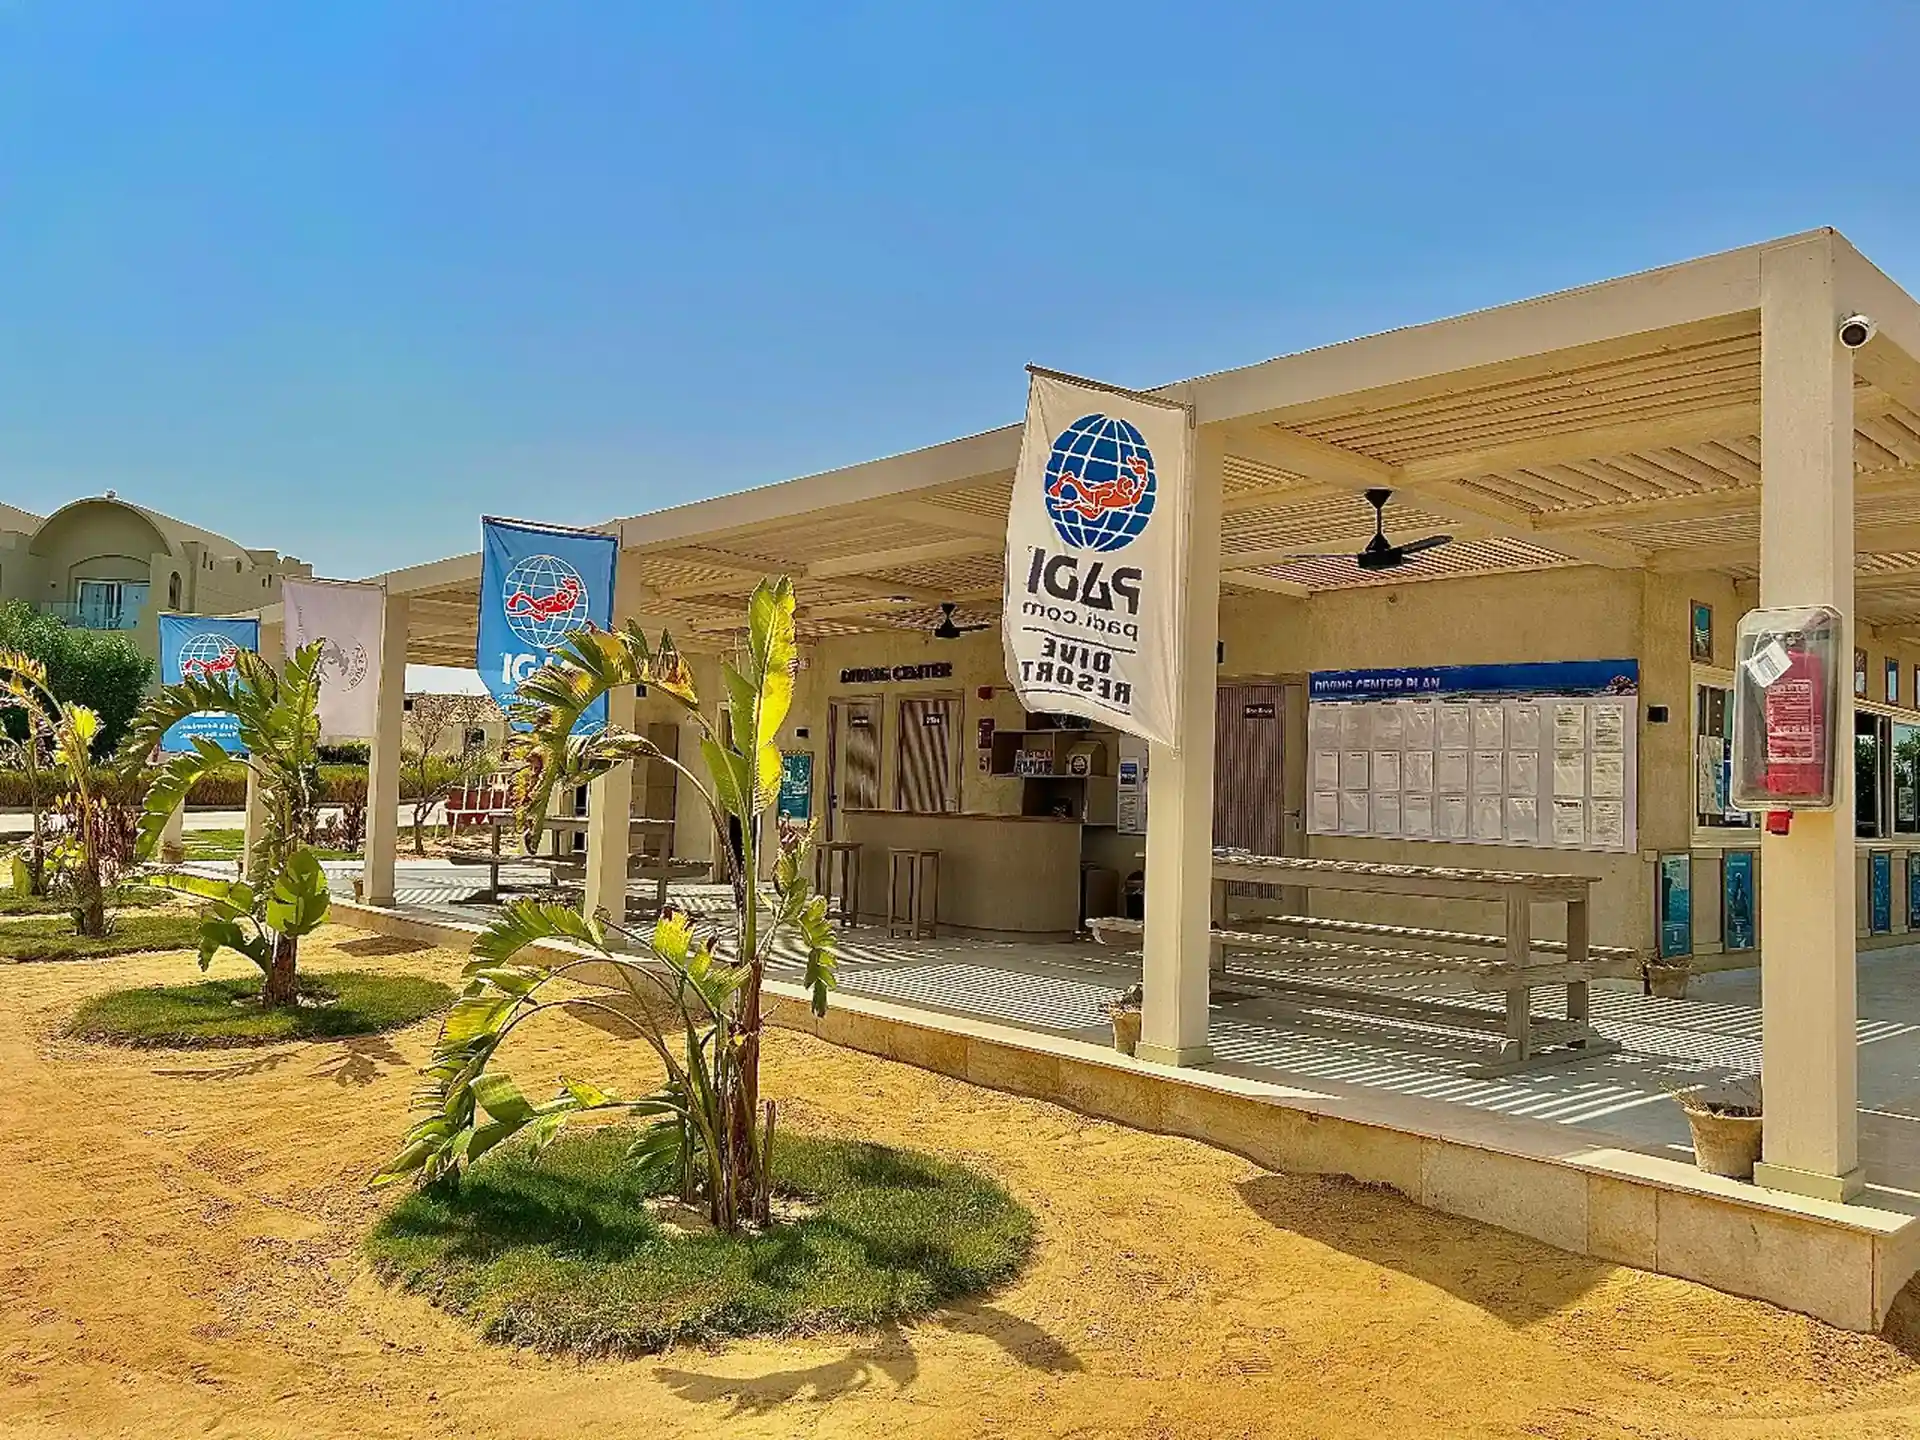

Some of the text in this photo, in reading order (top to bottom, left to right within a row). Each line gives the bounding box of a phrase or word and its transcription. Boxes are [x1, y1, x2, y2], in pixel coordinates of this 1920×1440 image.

[891, 661, 953, 681] CENTER
[1315, 676, 1441, 691] DIVING CENTER PLAN
